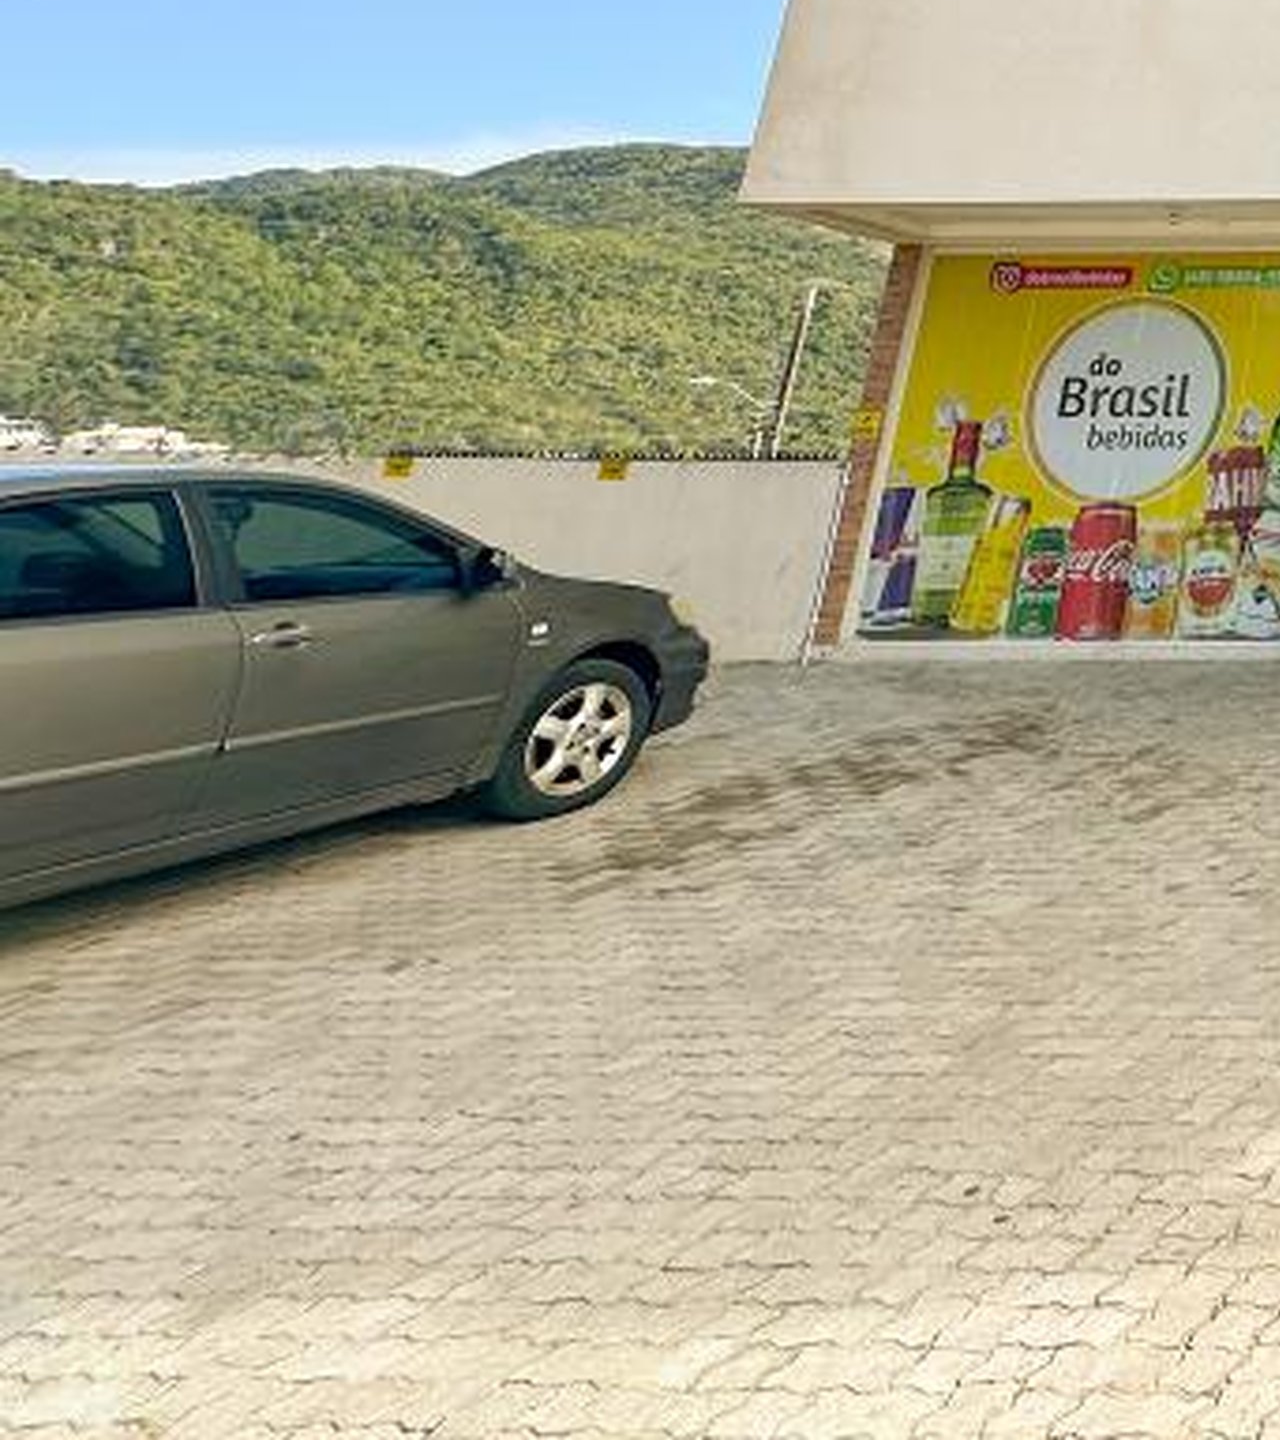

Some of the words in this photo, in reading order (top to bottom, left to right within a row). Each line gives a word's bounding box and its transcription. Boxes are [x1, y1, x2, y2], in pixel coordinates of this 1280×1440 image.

[1089, 353, 1122, 376] do
[1057, 375, 1191, 419] Brasil
[1086, 421, 1189, 451] bebidas
